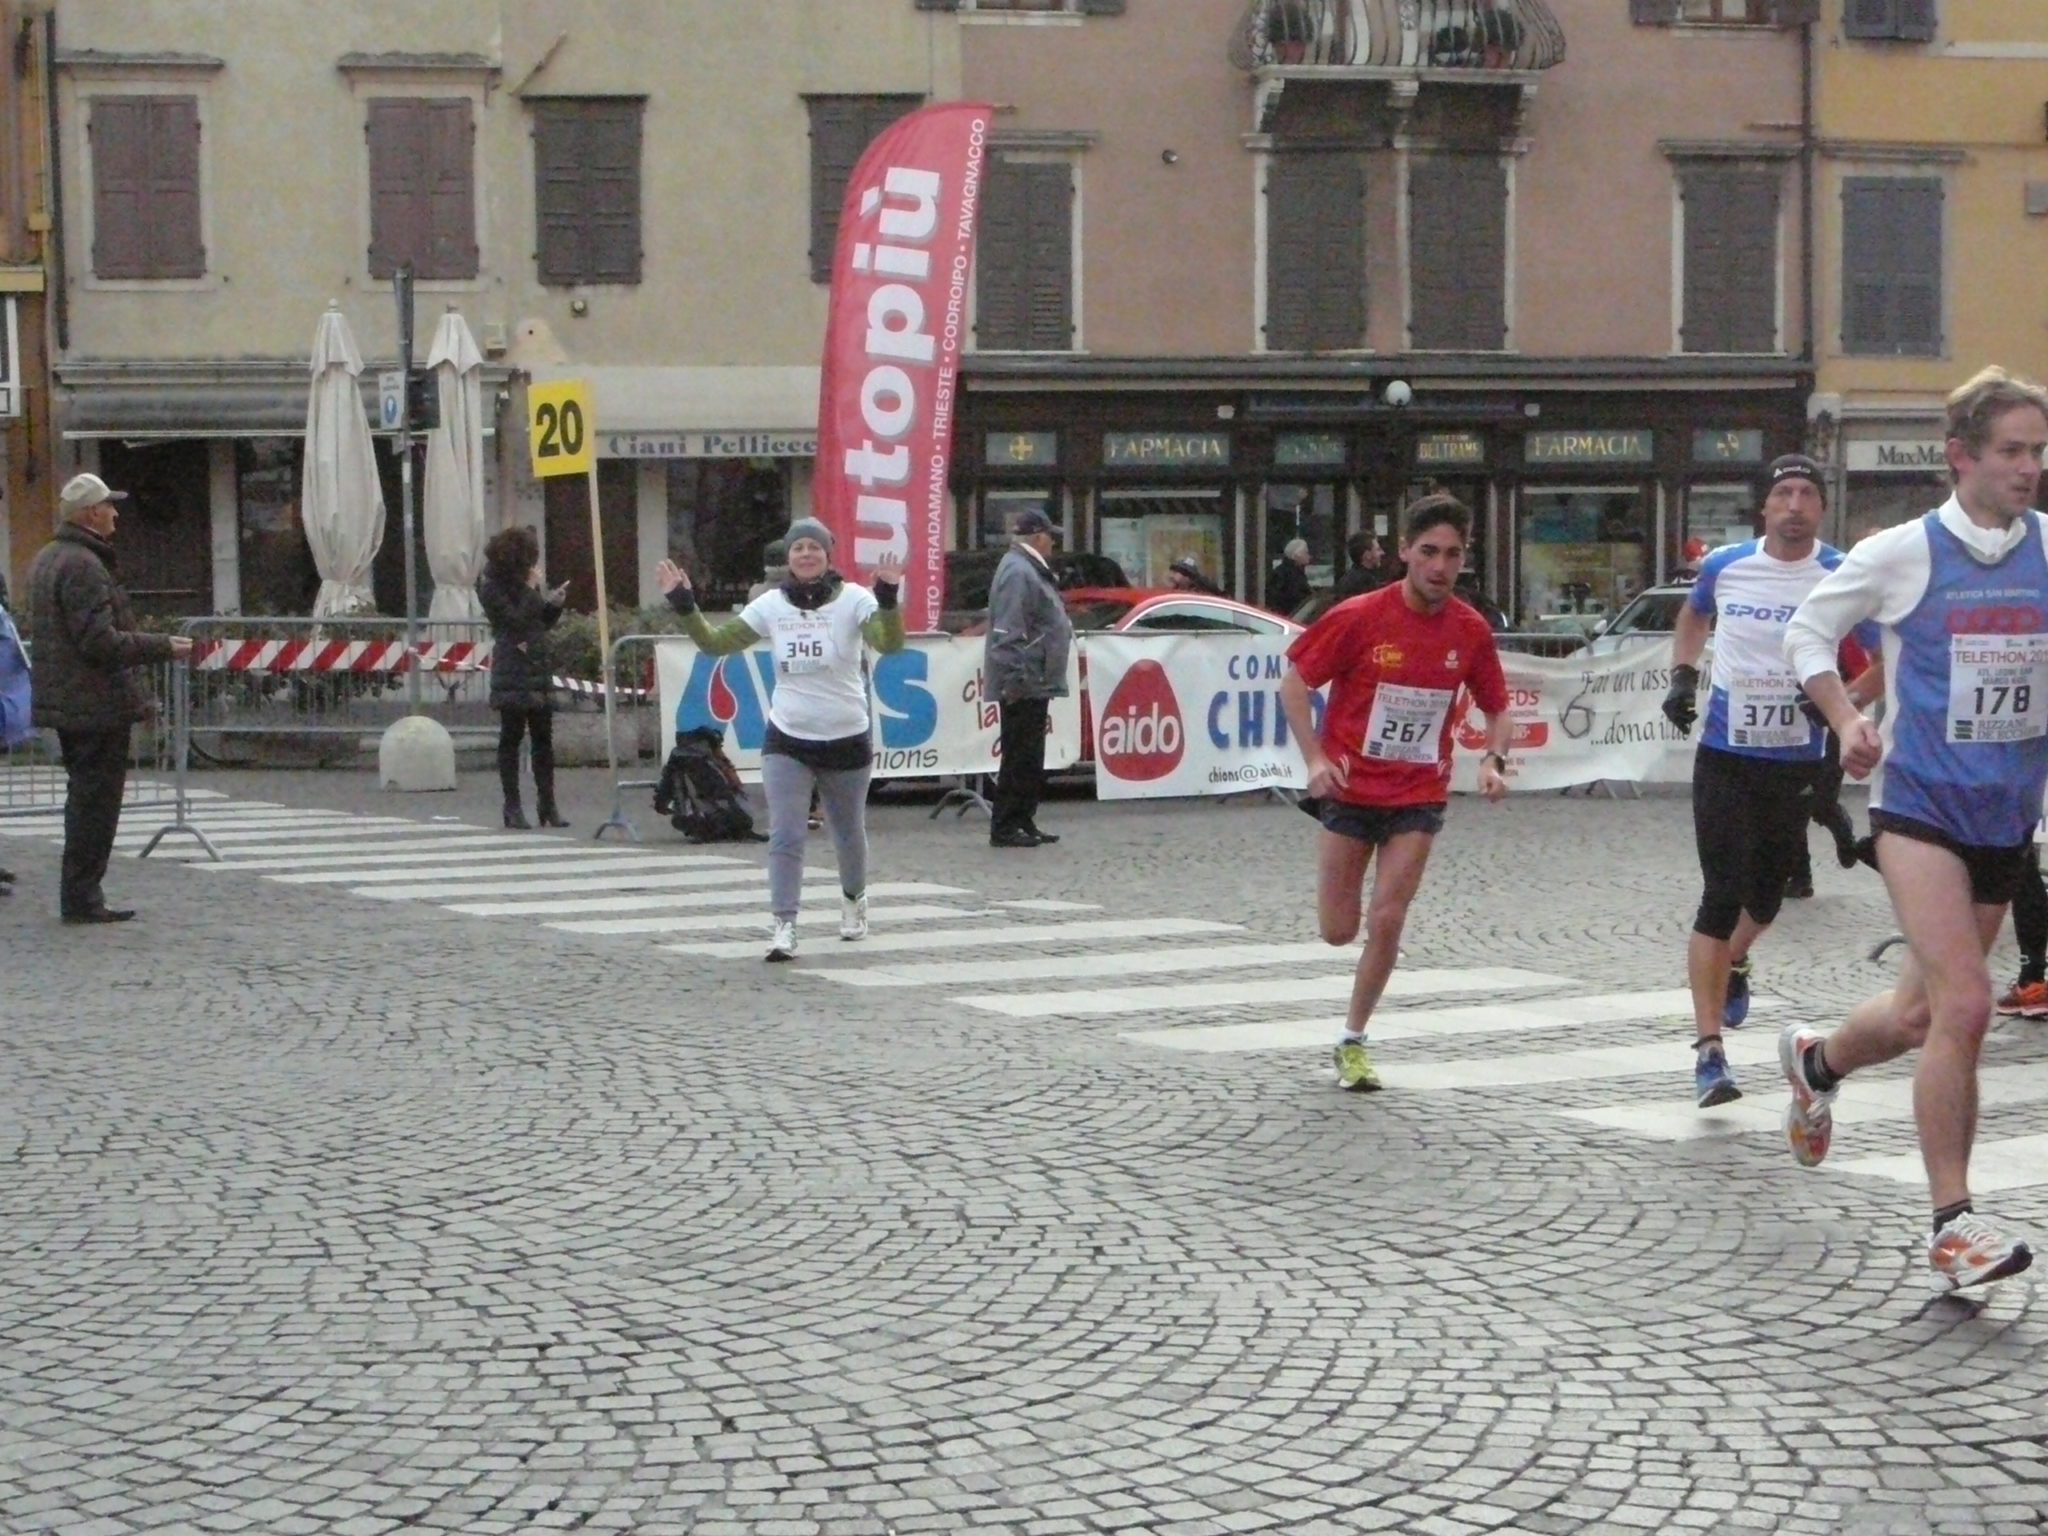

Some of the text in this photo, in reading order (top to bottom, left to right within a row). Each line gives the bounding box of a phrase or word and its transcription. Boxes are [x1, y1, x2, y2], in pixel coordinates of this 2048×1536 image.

[958, 118, 985, 241] TAVAGNACCO
[942, 255, 967, 352] CODROIPO
[844, 167, 940, 605] utopiù
[933, 368, 952, 440] TRIESTE
[535, 399, 583, 458] 20
[609, 436, 687, 455] Ciani
[1110, 439, 1221, 459] FARMACIA
[1534, 436, 1643, 457] FARMACIA
[1876, 445, 1945, 466] MaxMa
[928, 455, 944, 571] PRADAMANO
[786, 641, 823, 658] 346
[1955, 650, 2027, 664] TELETHON
[1974, 685, 2031, 715] 178
[1102, 702, 1180, 755] aido
[1743, 705, 1794, 727] 370
[1381, 720, 1431, 742] 267
